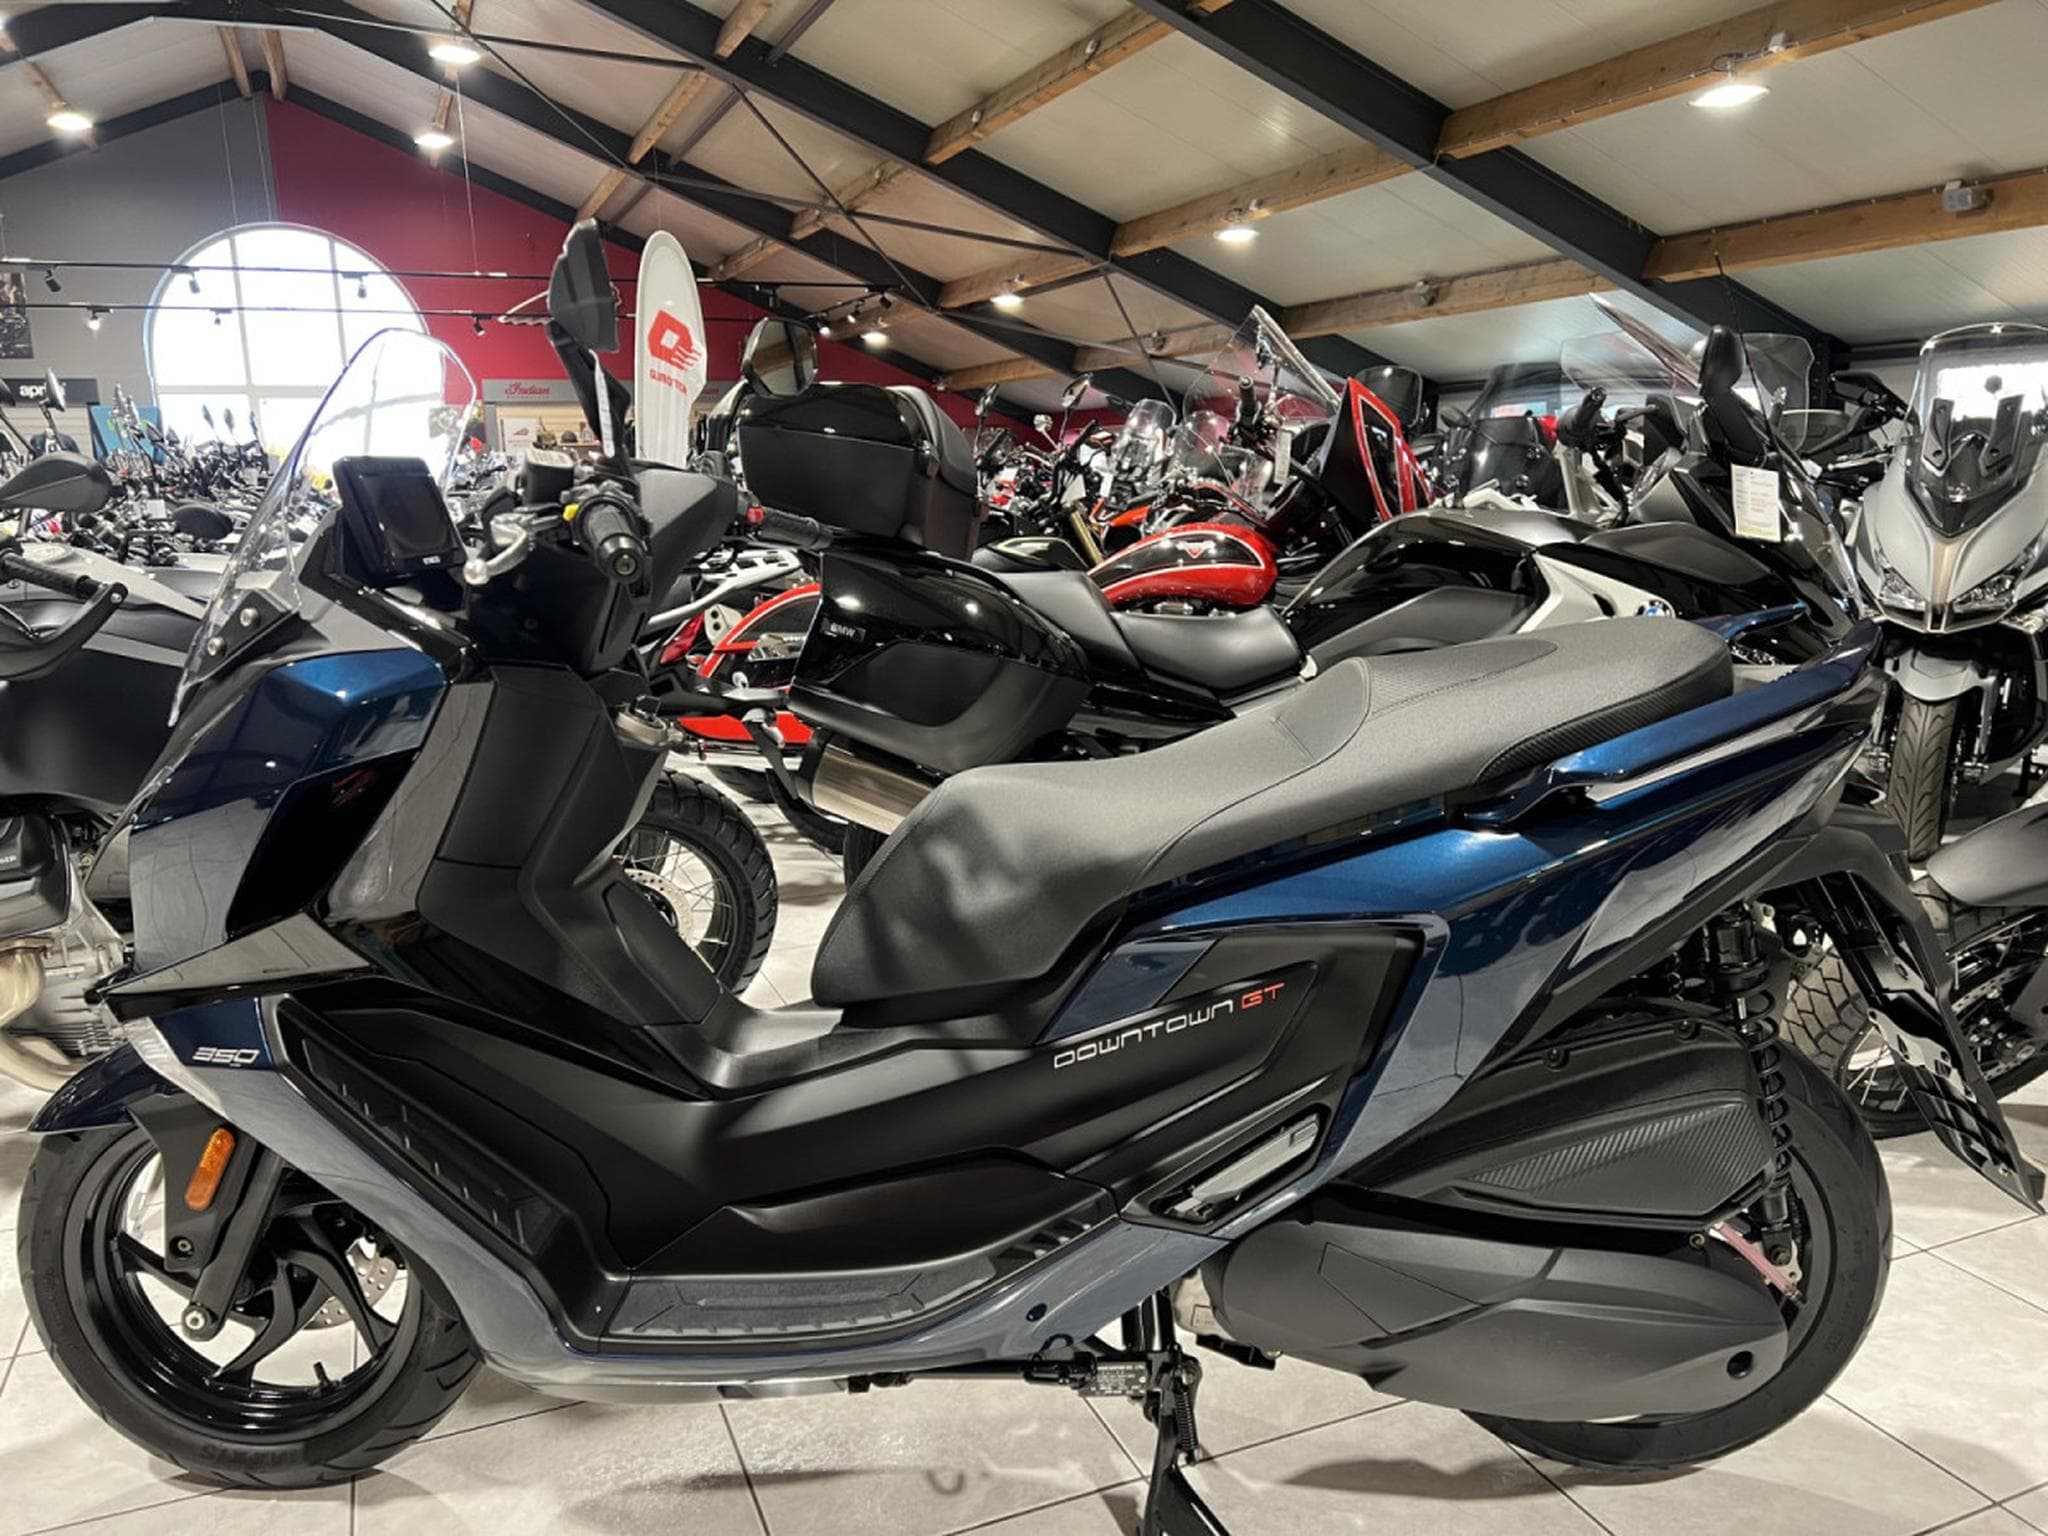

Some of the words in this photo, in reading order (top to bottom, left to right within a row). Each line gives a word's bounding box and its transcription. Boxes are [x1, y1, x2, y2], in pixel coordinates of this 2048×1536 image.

[504, 382, 550, 395] Indian
[1054, 999, 1234, 1069] DOWNTOWN
[1241, 982, 1285, 1009] GT
[192, 1046, 260, 1065] 350
